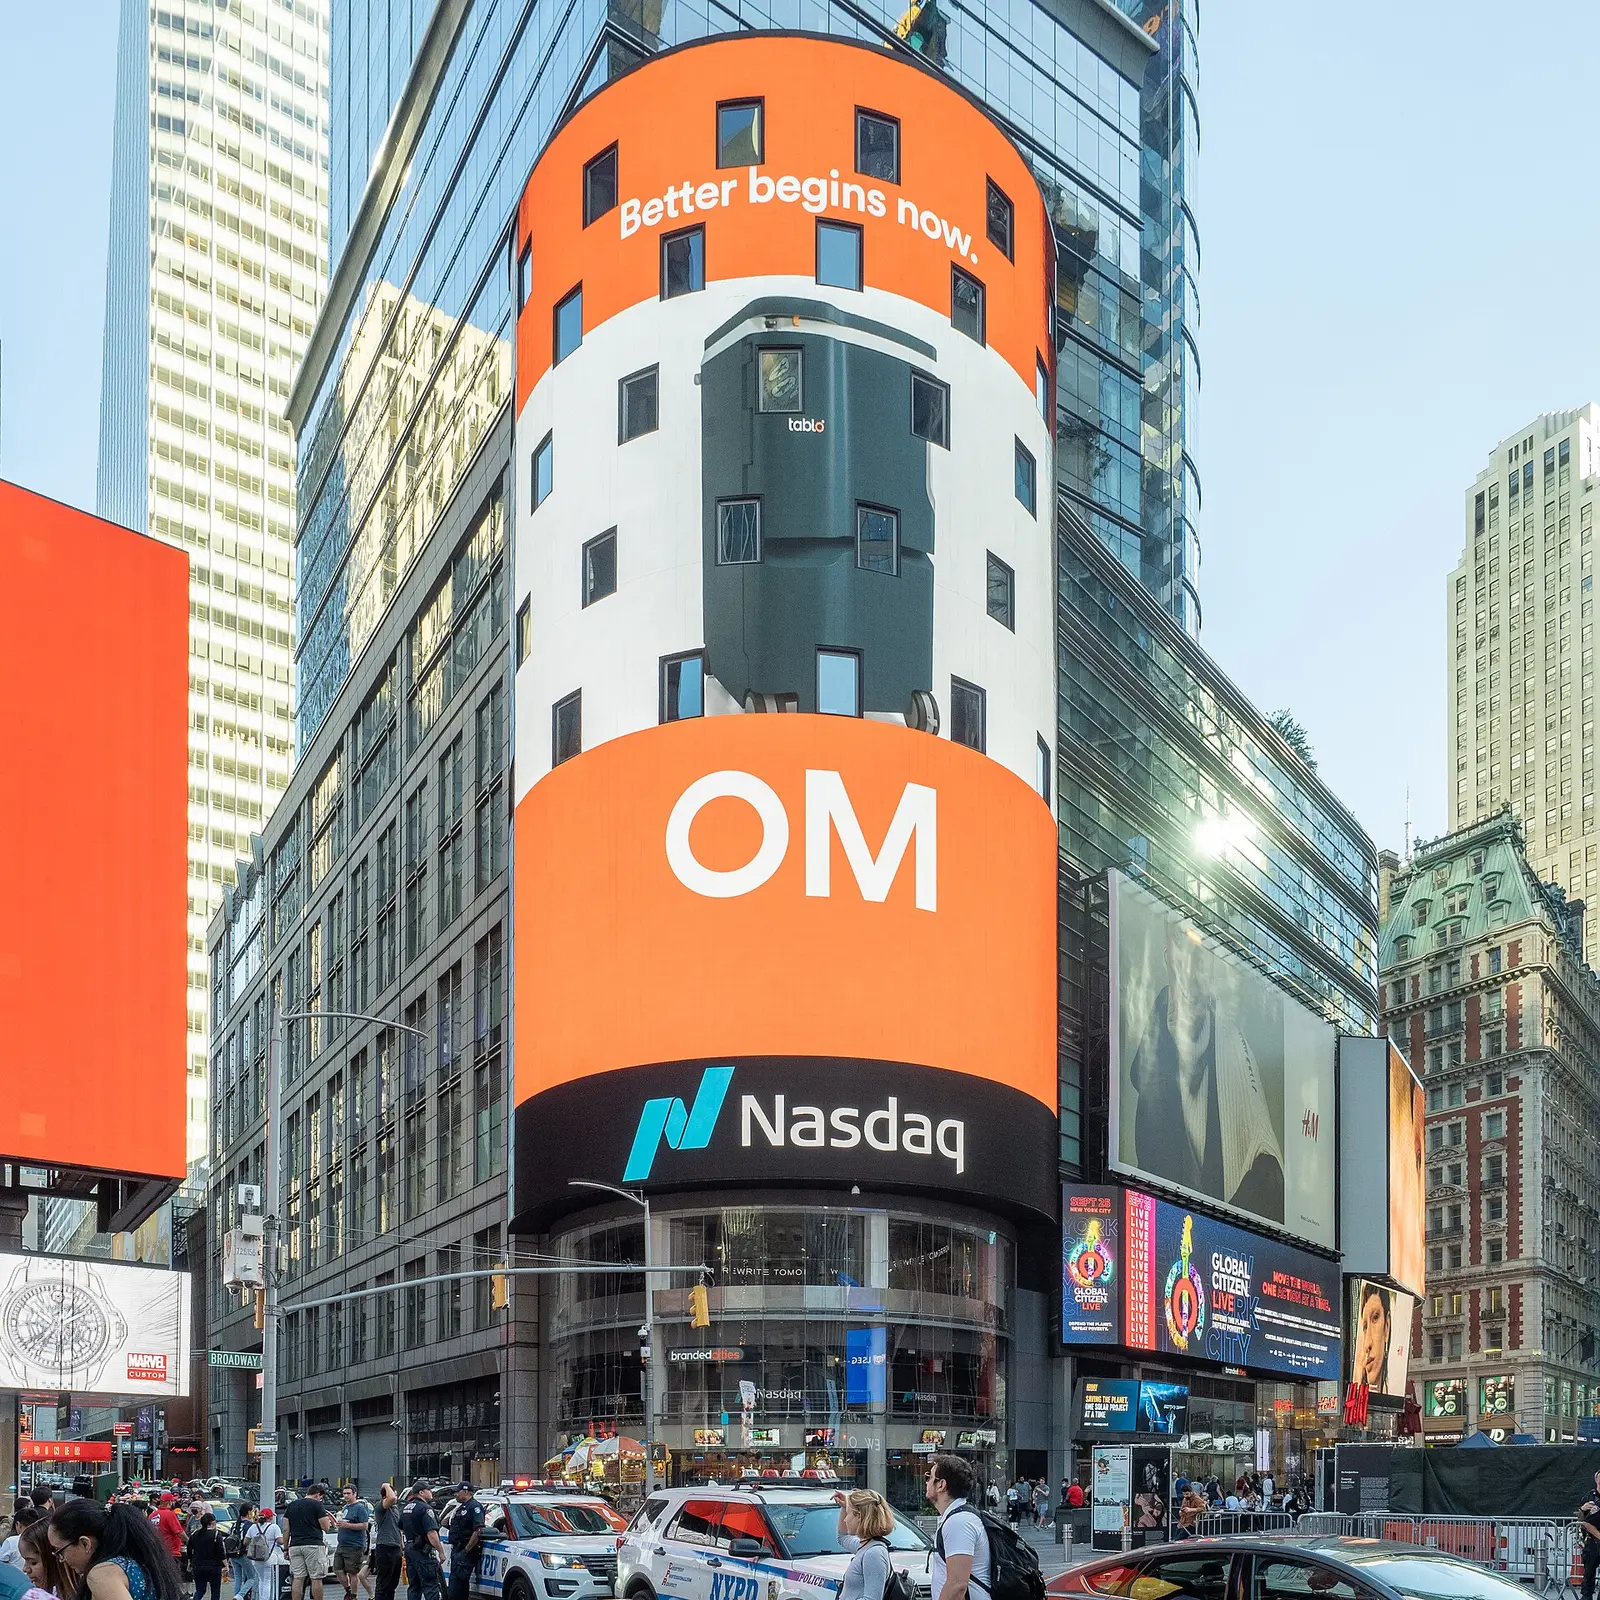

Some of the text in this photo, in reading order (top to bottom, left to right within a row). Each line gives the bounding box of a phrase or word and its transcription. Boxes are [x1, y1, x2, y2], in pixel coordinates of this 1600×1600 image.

[620, 166, 979, 264] Better begins now.
[788, 417, 825, 433] tablo
[665, 769, 937, 913] OM
[1302, 1108, 1319, 1143] H&M
[741, 1094, 965, 1175] Nasdaq
[1070, 1197, 1097, 1207] SEPT
[1130, 1207, 1148, 1220] LIVE
[1130, 1217, 1148, 1230] LIVE
[1130, 1228, 1148, 1241] LIVE
[1130, 1239, 1148, 1251] LIVE
[1130, 1249, 1148, 1261] LIVE
[1130, 1260, 1148, 1272] LIVE
[1211, 1252, 1250, 1279] GLOBAL
[1130, 1270, 1148, 1282] LIVE
[1273, 1271, 1289, 1286] MOVE
[1290, 1275, 1301, 1289] THE
[1074, 1288, 1108, 1296] GLOBAL
[1130, 1281, 1148, 1292] LIVE
[1262, 1282, 1276, 1297] ONE
[1130, 1291, 1148, 1303] LIVE
[1212, 1290, 1235, 1312] LIVE
[1082, 1303, 1101, 1311] LIVE
[1130, 1302, 1148, 1313] LIVE
[1130, 1312, 1148, 1324] LIVE
[1130, 1323, 1148, 1334] LIVE
[1130, 1333, 1148, 1344] LIVE
[128, 1354, 165, 1369] MARVEL
[211, 1353, 259, 1367] BROADWAY
[671, 1350, 740, 1361] brandedcities
[129, 1371, 165, 1379] CUSTOM
[756, 1388, 802, 1401] Nasdaq
[915, 1393, 937, 1402] Nasdaq
[1084, 1403, 1095, 1411] ONE
[1110, 1404, 1128, 1412] PROJECT
[1344, 1383, 1369, 1427] H&M
[1490, 1429, 1504, 1442] JD
[34, 1445, 81, 1456] DINER
[709, 1572, 760, 1600] NYPD
[799, 1573, 825, 1588] POLICE
